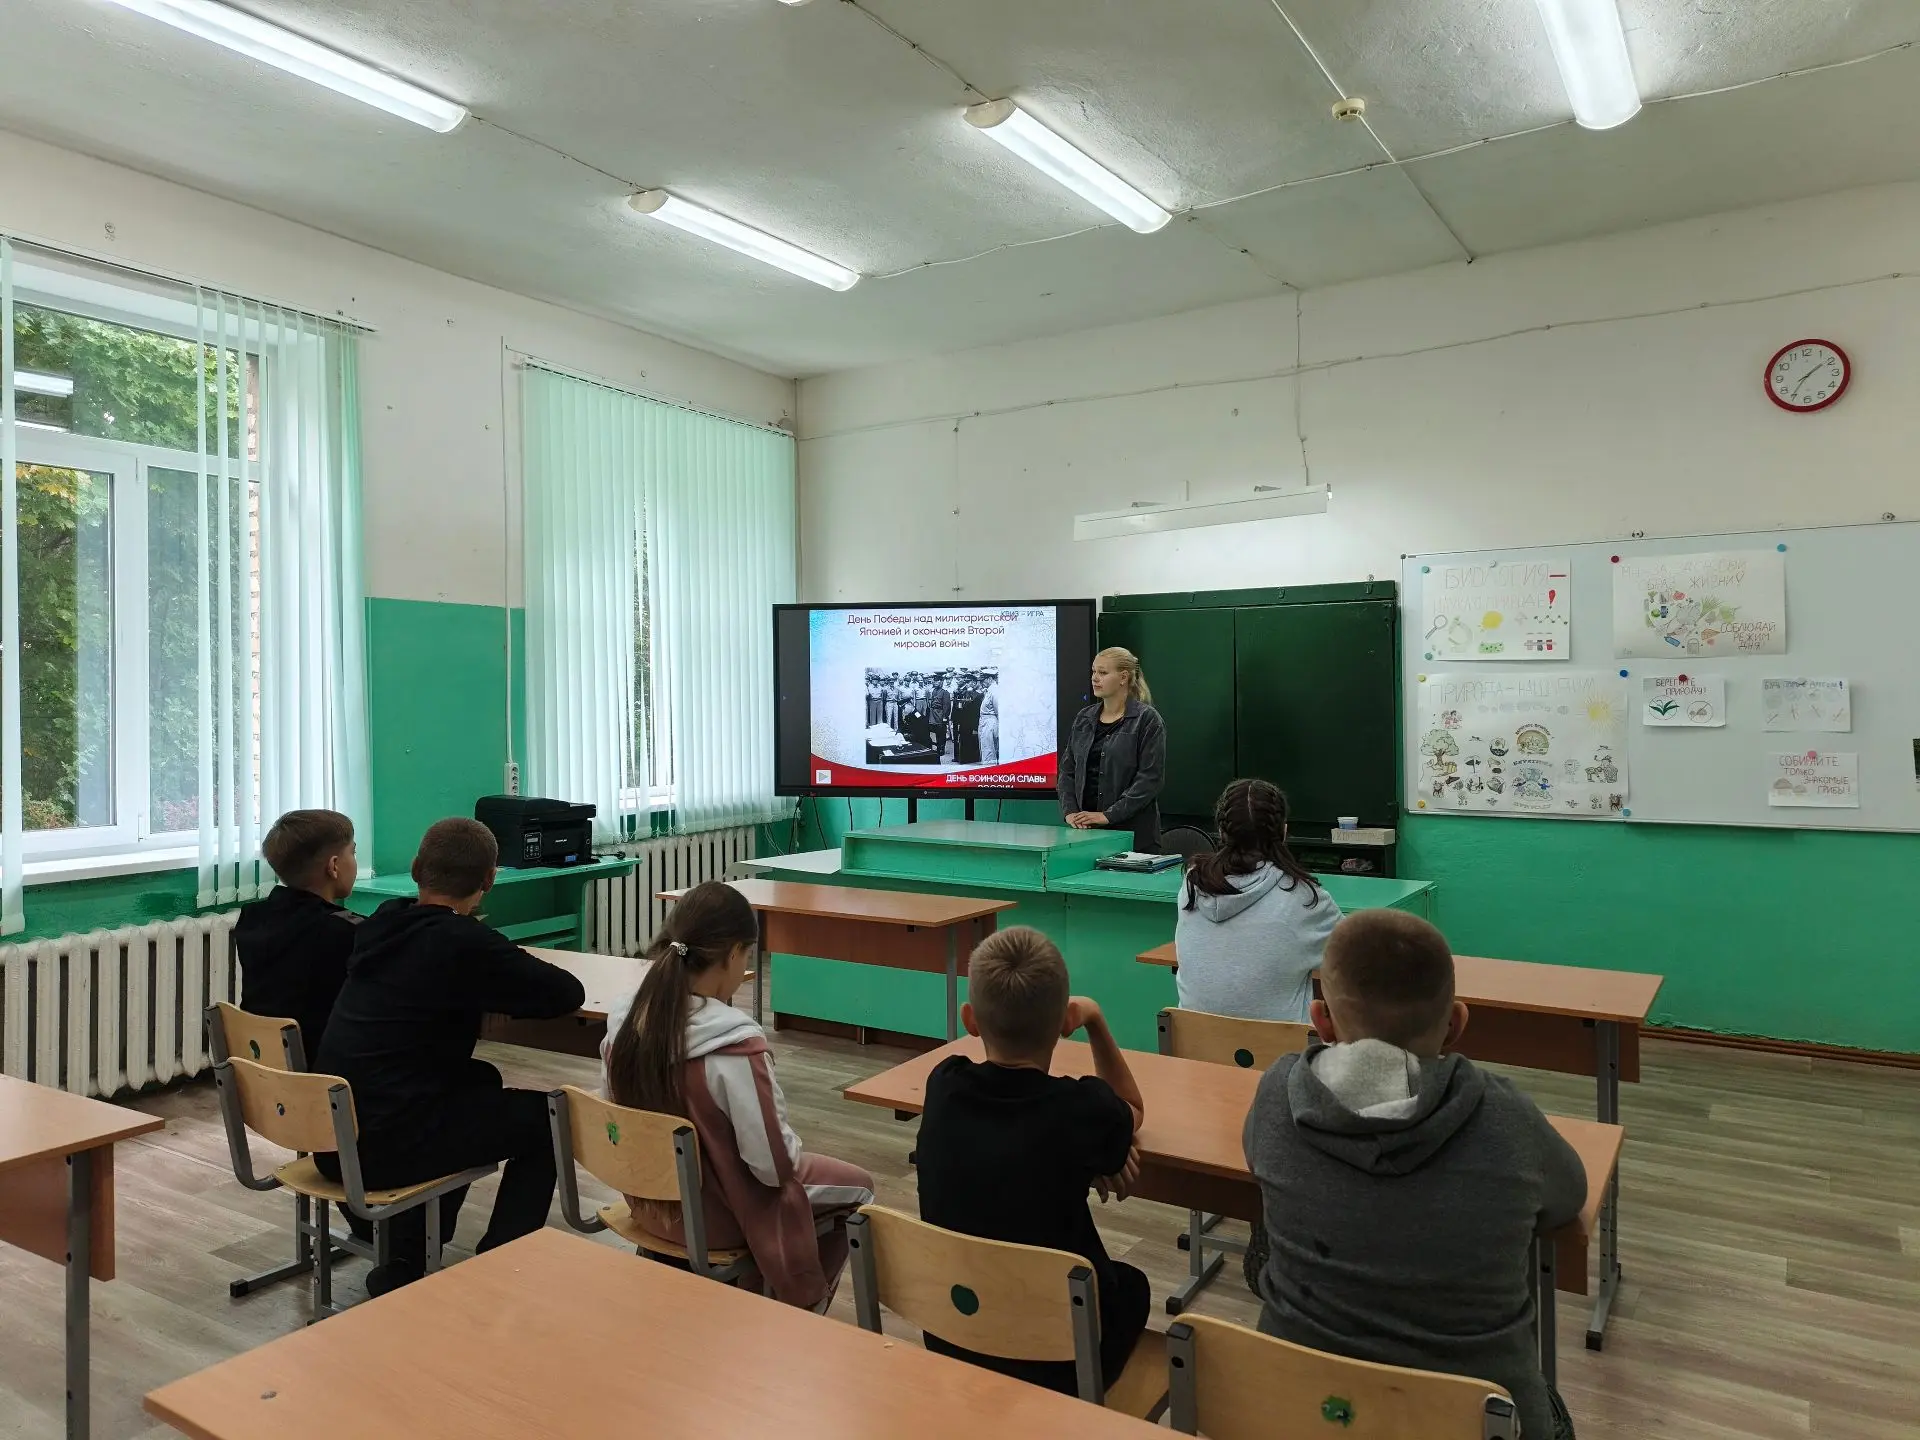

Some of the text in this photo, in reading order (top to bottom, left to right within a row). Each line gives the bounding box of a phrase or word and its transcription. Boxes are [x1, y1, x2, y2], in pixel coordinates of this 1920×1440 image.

[1789, 353, 1797, 361] 11
[1801, 348, 1812, 357] 12
[1819, 350, 1823, 358] 1
[1827, 357, 1836, 366] 2
[1779, 363, 1790, 371] 10
[1831, 368, 1840, 377] 3
[1776, 375, 1784, 384] 9
[1780, 387, 1789, 395] 8
[1817, 391, 1826, 399] 5
[1790, 393, 1798, 401] 7
[1803, 396, 1812, 404] 6
[847, 614, 1018, 624] День Победы над милитаристской
[859, 627, 902, 636] Японией
[912, 627, 966, 635] окончания
[967, 626, 1005, 636] Второй
[1733, 632, 1770, 641] РЕЖИМ
[893, 639, 970, 649] мировой войны
[946, 773, 1047, 783] ДЕНЬ ВОИНСКОЙ СЛАВЫ
